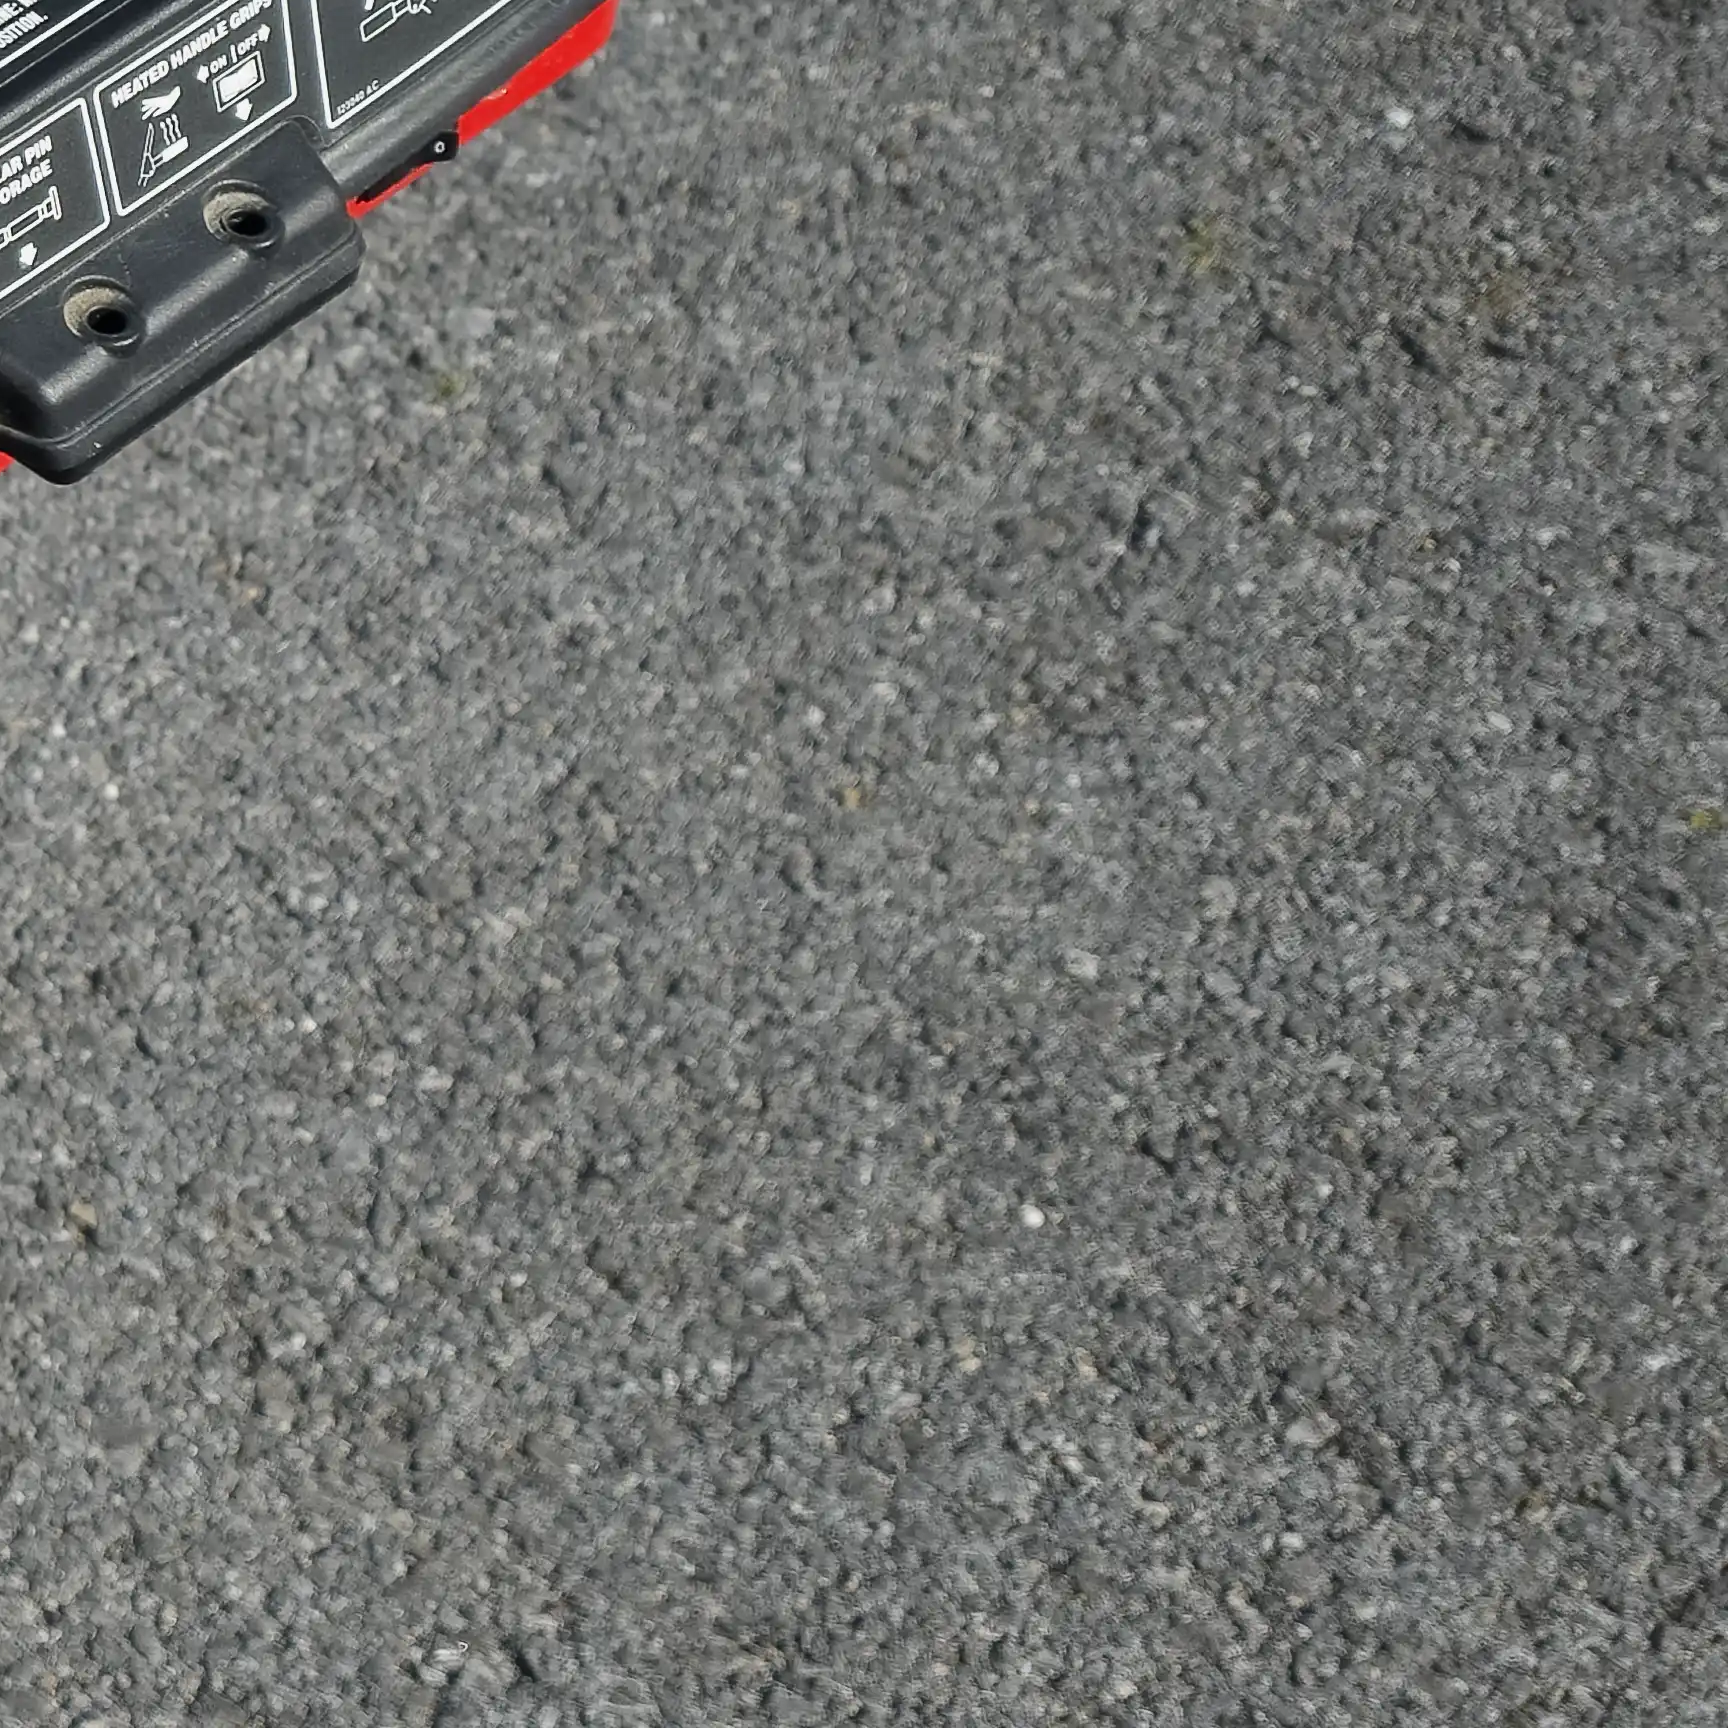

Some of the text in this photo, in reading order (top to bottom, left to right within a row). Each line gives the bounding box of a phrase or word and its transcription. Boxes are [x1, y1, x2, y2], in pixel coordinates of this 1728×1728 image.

[110, 60, 169, 108] HEATED
[170, 19, 228, 69] HANDLE
[209, 32, 258, 73] ON OFF
[24, 135, 52, 165] PIN
